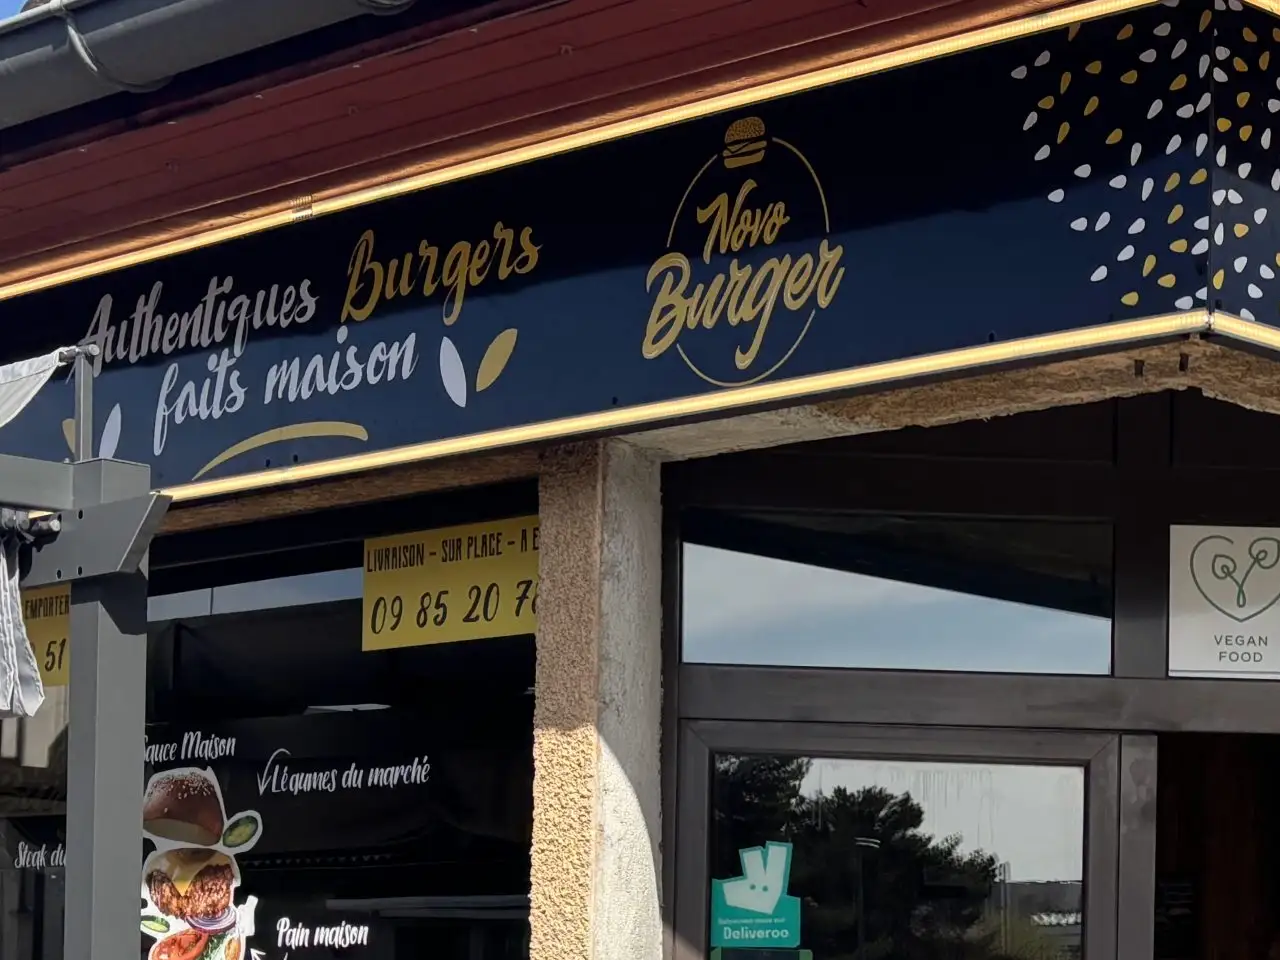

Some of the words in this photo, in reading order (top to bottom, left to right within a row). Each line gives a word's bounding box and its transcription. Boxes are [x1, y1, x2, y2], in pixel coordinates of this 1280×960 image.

[696, 178, 790, 264] Novo
[65, 275, 322, 384] Authentiques
[340, 220, 544, 326] Burgers
[641, 238, 846, 370] Burger
[153, 353, 249, 456] faits
[263, 325, 420, 405] maison
[367, 542, 425, 573] LIVRAISON
[441, 538, 462, 563] SUR
[467, 532, 503, 559] PLACE
[370, 595, 404, 635] 09
[416, 590, 449, 629] 85
[462, 582, 500, 623] 20
[44, 638, 67, 672] 51
[1214, 634, 1269, 647] VEGAN
[1218, 651, 1263, 663] FOOD
[181, 731, 236, 760] Maison
[271, 764, 338, 796] Légumes
[341, 762, 364, 789] du
[367, 755, 431, 789] marché
[15, 841, 47, 871] Steak
[276, 917, 311, 950] Pain
[313, 920, 369, 949] maison
[723, 926, 790, 940] Deliveroo
